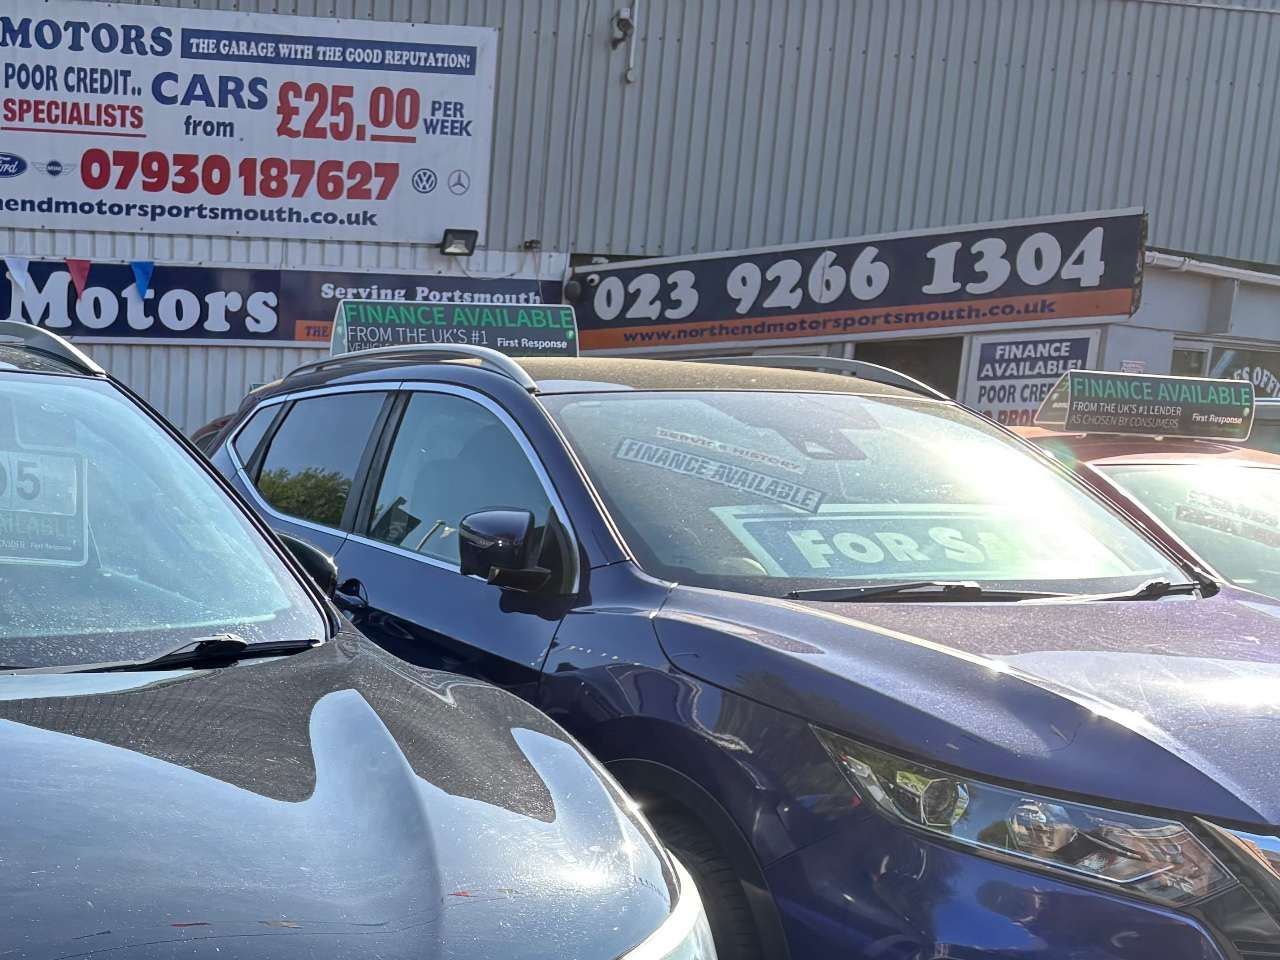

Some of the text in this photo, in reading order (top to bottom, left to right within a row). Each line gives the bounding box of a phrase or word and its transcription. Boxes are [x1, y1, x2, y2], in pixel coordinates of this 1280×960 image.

[0, 17, 173, 57] MOTORS
[190, 38, 470, 69] THE GARAGE WITH THE GOOD REPUTATION!
[4, 63, 58, 92] POOR
[151, 71, 268, 110] CARS
[3, 98, 145, 130] SPECIALISTS
[276, 80, 420, 142] £25.00
[430, 100, 465, 119] PER
[183, 115, 235, 138] from
[423, 118, 473, 138] WEEK
[80, 147, 401, 201] 07930 187627
[593, 226, 1106, 321] 023 9266 1304
[5, 270, 279, 334] Motors
[320, 283, 541, 305] Serving Portsmouth
[345, 304, 575, 329] FINANCE AVAILABLE
[623, 299, 1057, 343] www.northendmotorsportsmouth.co.uk
[348, 326, 392, 342] FROM
[396, 327, 427, 343] THE
[471, 330, 488, 345] #1
[497, 337, 567, 350] First Response
[995, 342, 1071, 360] FINANCE
[978, 384, 1017, 404] POOR
[1073, 378, 1251, 407] FINANCE AVAILABLE
[1072, 402, 1098, 412] FROM
[1099, 402, 1115, 413] THE
[1150, 405, 1182, 416] LENDER
[1192, 413, 1243, 424] First Response
[623, 441, 816, 508] FINANCE AVAILABLE
[786, 528, 930, 569] FOR
